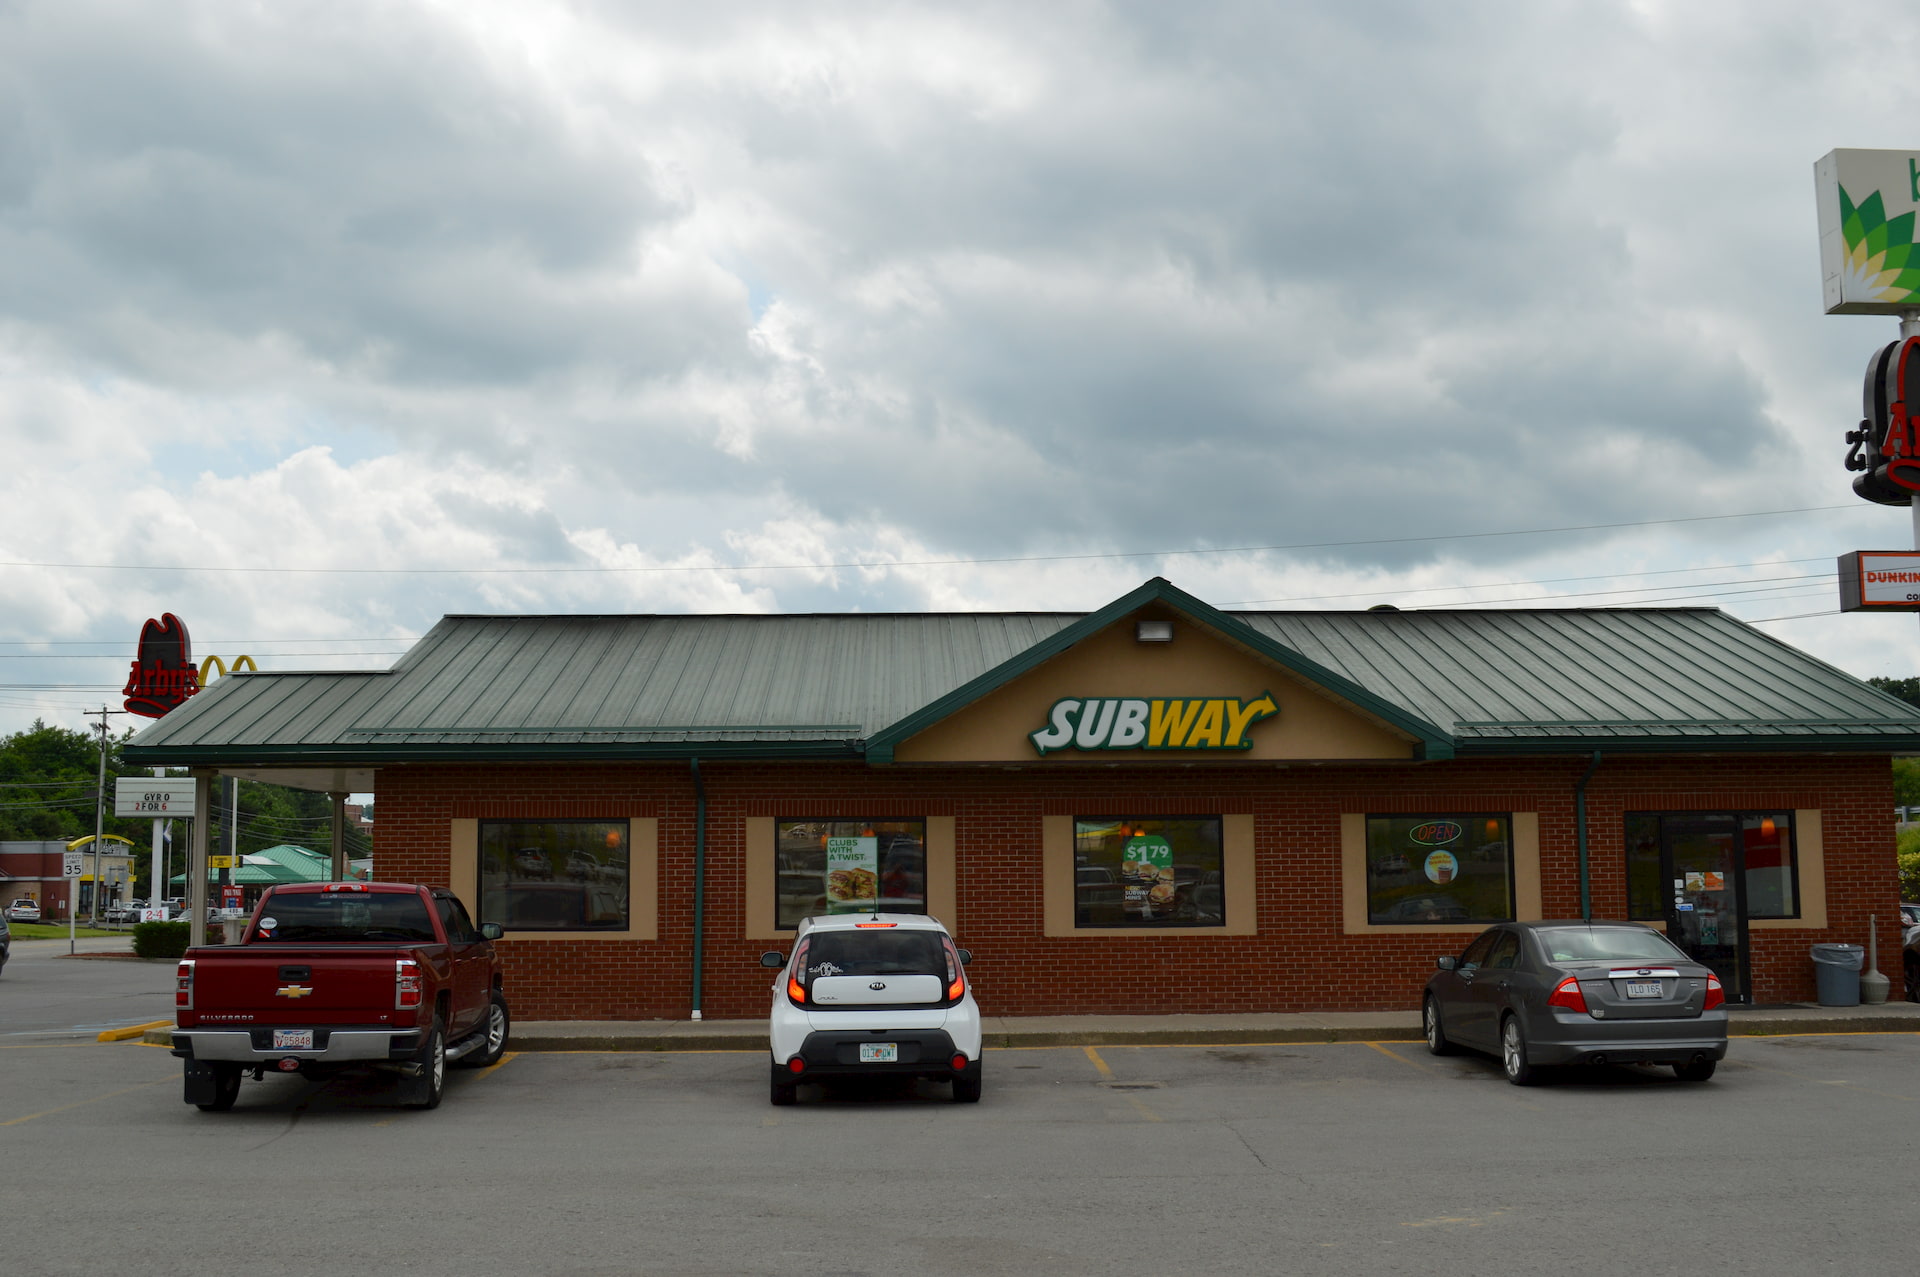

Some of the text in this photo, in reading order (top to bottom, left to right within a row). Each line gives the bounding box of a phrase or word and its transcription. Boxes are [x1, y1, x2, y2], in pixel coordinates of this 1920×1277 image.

[122, 659, 199, 704] Arby's
[1032, 696, 1278, 751] SUBWAY
[135, 802, 167, 811] 2 FOR 6
[1417, 824, 1455, 841] OPEN
[65, 865, 82, 875] 35
